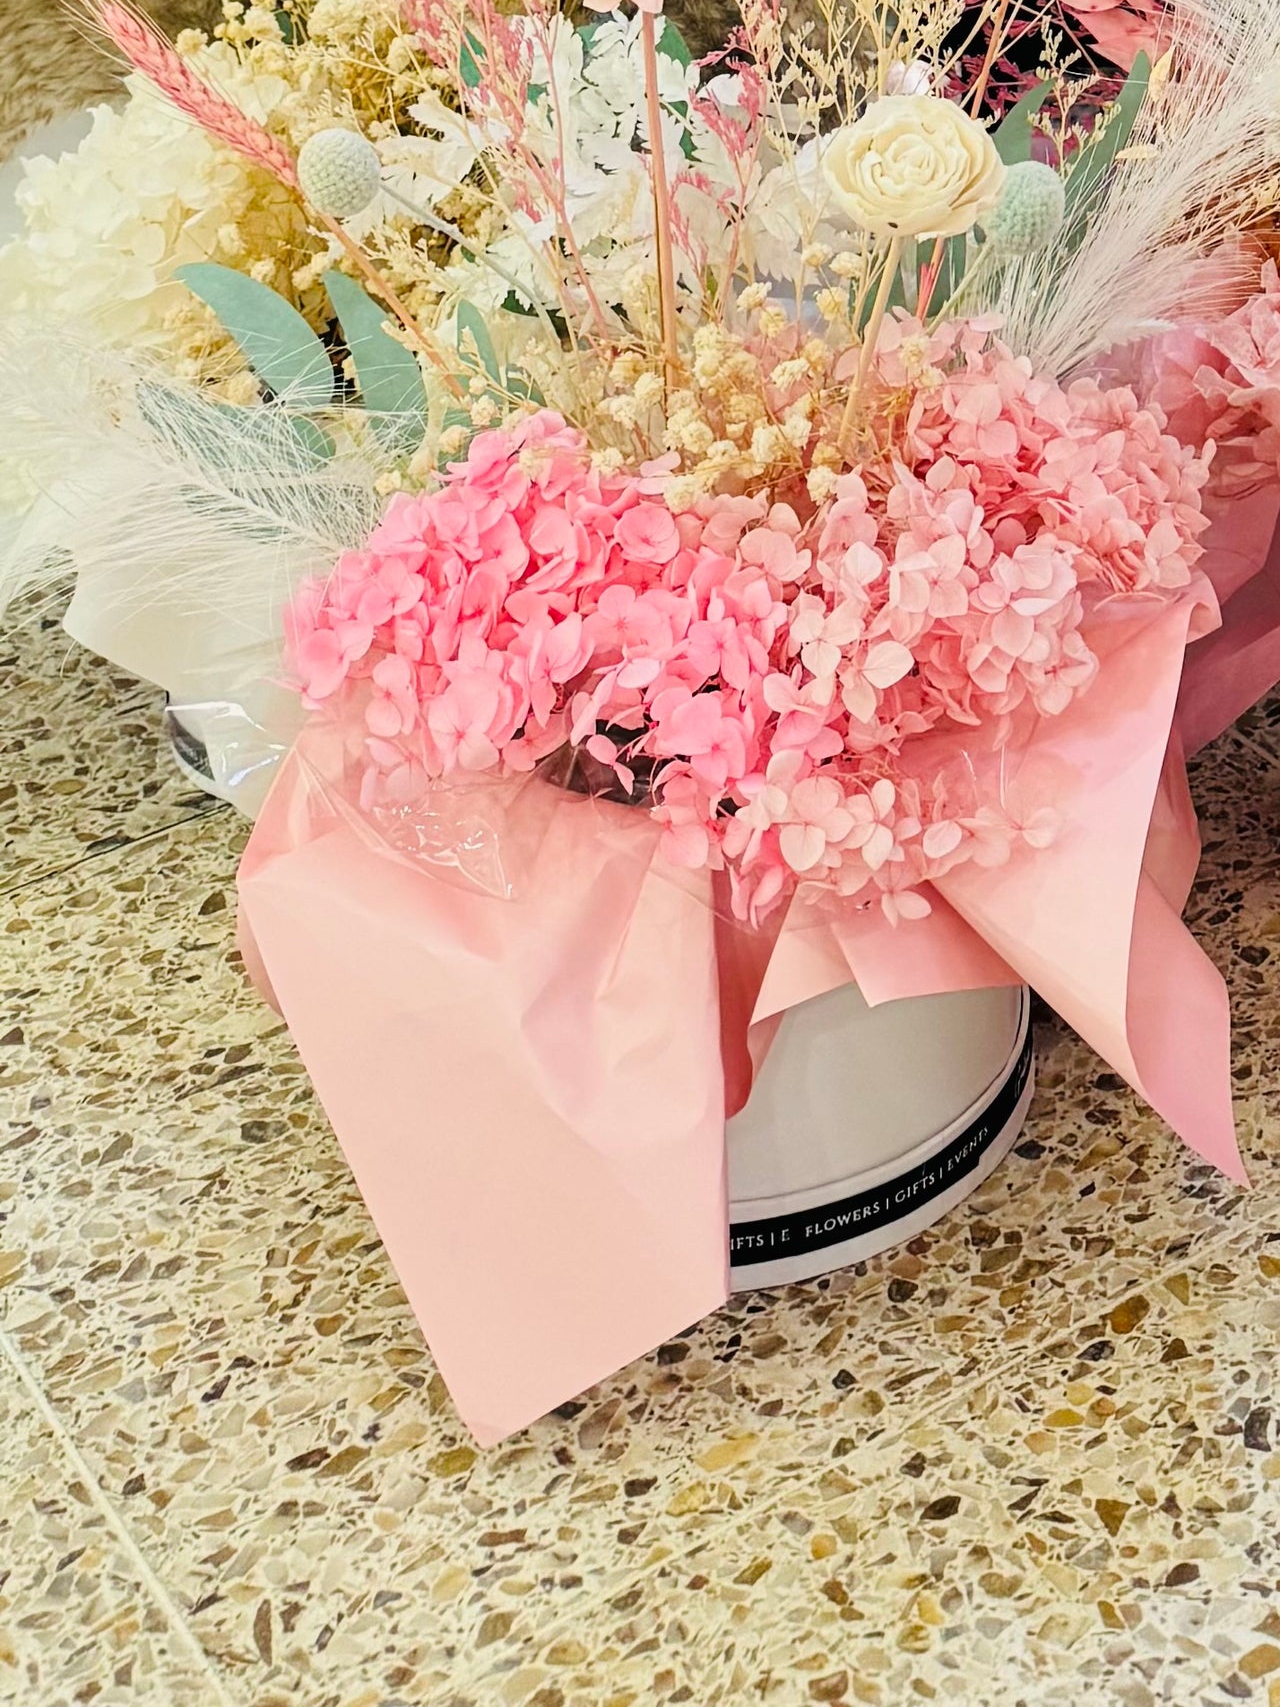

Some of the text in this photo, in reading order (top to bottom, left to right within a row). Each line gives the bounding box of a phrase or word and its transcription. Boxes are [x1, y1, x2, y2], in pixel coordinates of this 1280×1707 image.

[804, 1201, 881, 1239] FLOWERS
[894, 1172, 936, 1205] GIFTS
[946, 1125, 990, 1172] EVENTS
[730, 1232, 765, 1252] IFTS
